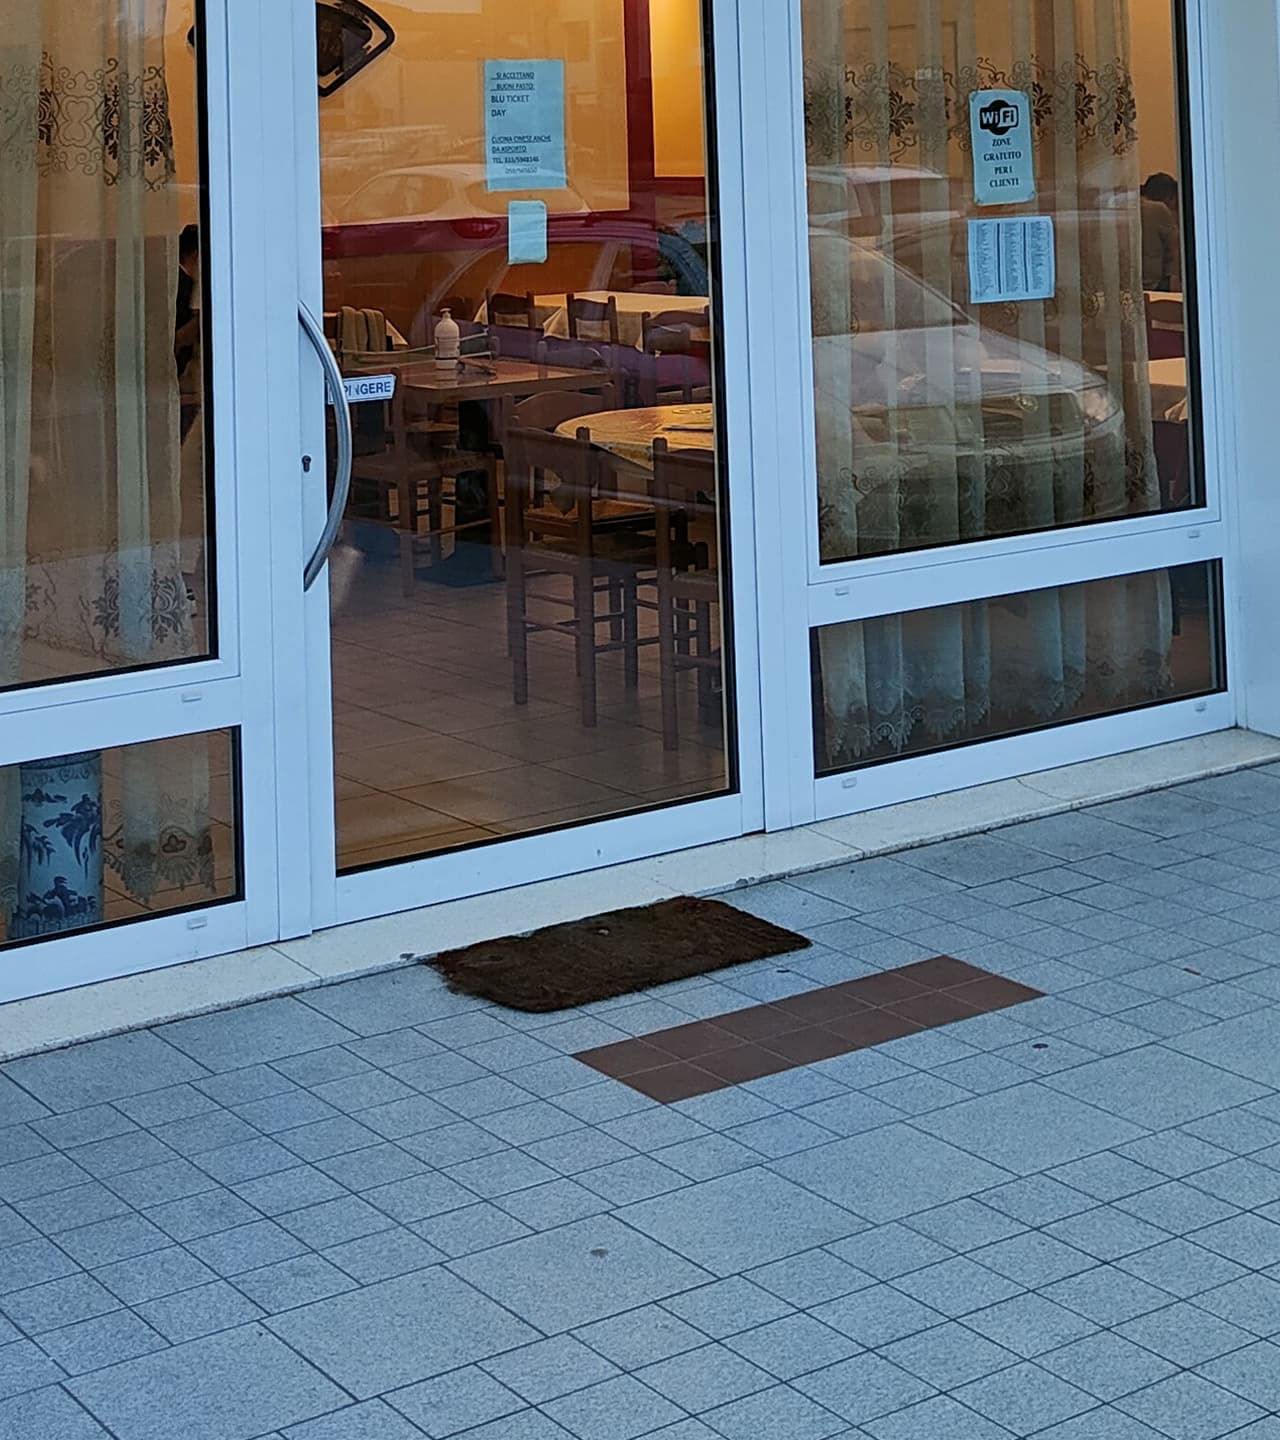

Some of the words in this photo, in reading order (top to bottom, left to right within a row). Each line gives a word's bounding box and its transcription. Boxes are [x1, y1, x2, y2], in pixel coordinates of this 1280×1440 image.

[491, 95, 505, 103] BLU
[506, 94, 529, 103] TICKET
[491, 109, 506, 117] DAY
[992, 137, 1011, 147] ZONE
[983, 151, 1022, 162] GRATUITO
[994, 166, 1008, 176] PER
[989, 177, 1019, 188] CLIENTI
[342, 381, 391, 396] PINGERE
